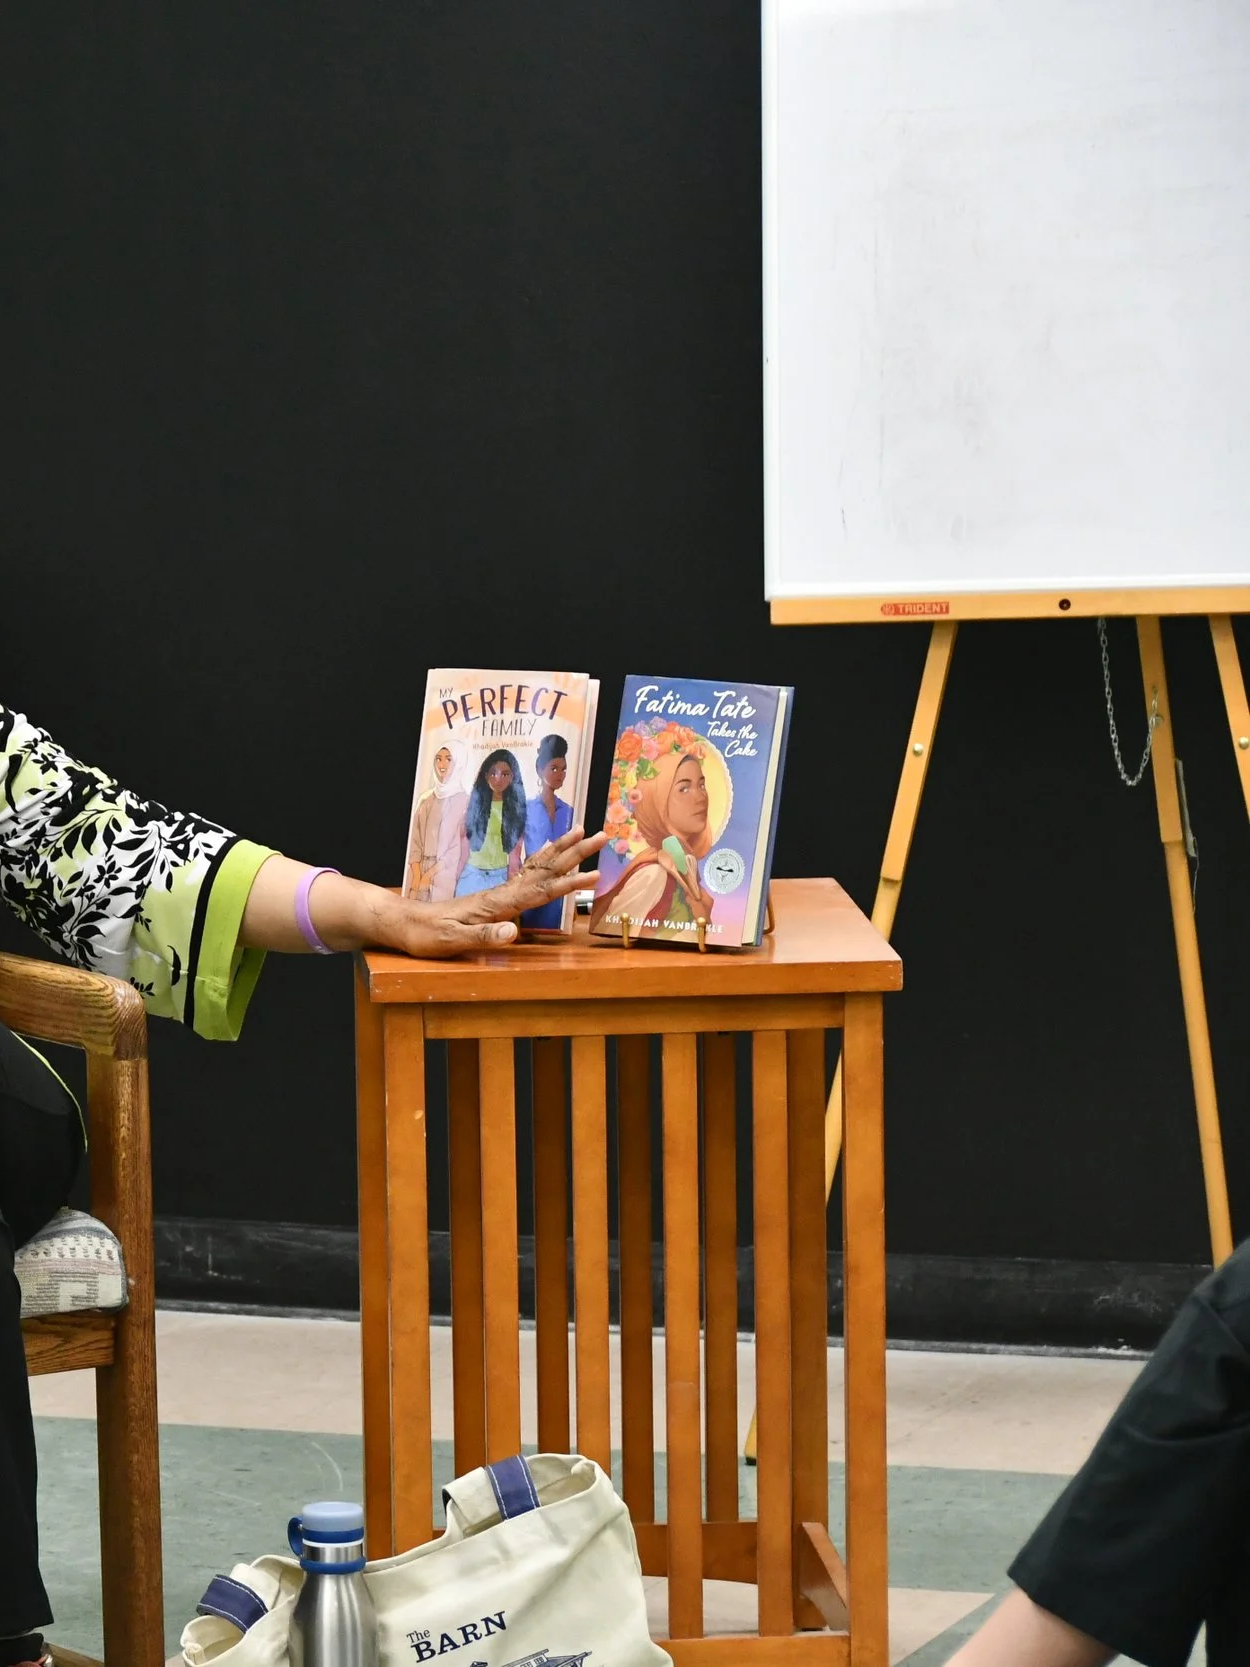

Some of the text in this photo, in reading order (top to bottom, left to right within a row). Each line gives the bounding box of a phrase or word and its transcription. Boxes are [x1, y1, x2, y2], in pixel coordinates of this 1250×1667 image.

[899, 603, 947, 613] TRIDENT
[439, 687, 454, 698] MY
[442, 684, 568, 730] PERFECT
[634, 685, 757, 719] Fatima Tate
[482, 718, 537, 737] FAMILY
[707, 721, 758, 740] Takes the
[724, 740, 758, 758] Cake
[605, 915, 724, 933] KHDIJAH VANBRKLE
[406, 1630, 430, 1644] The
[410, 1611, 507, 1663] BARN
